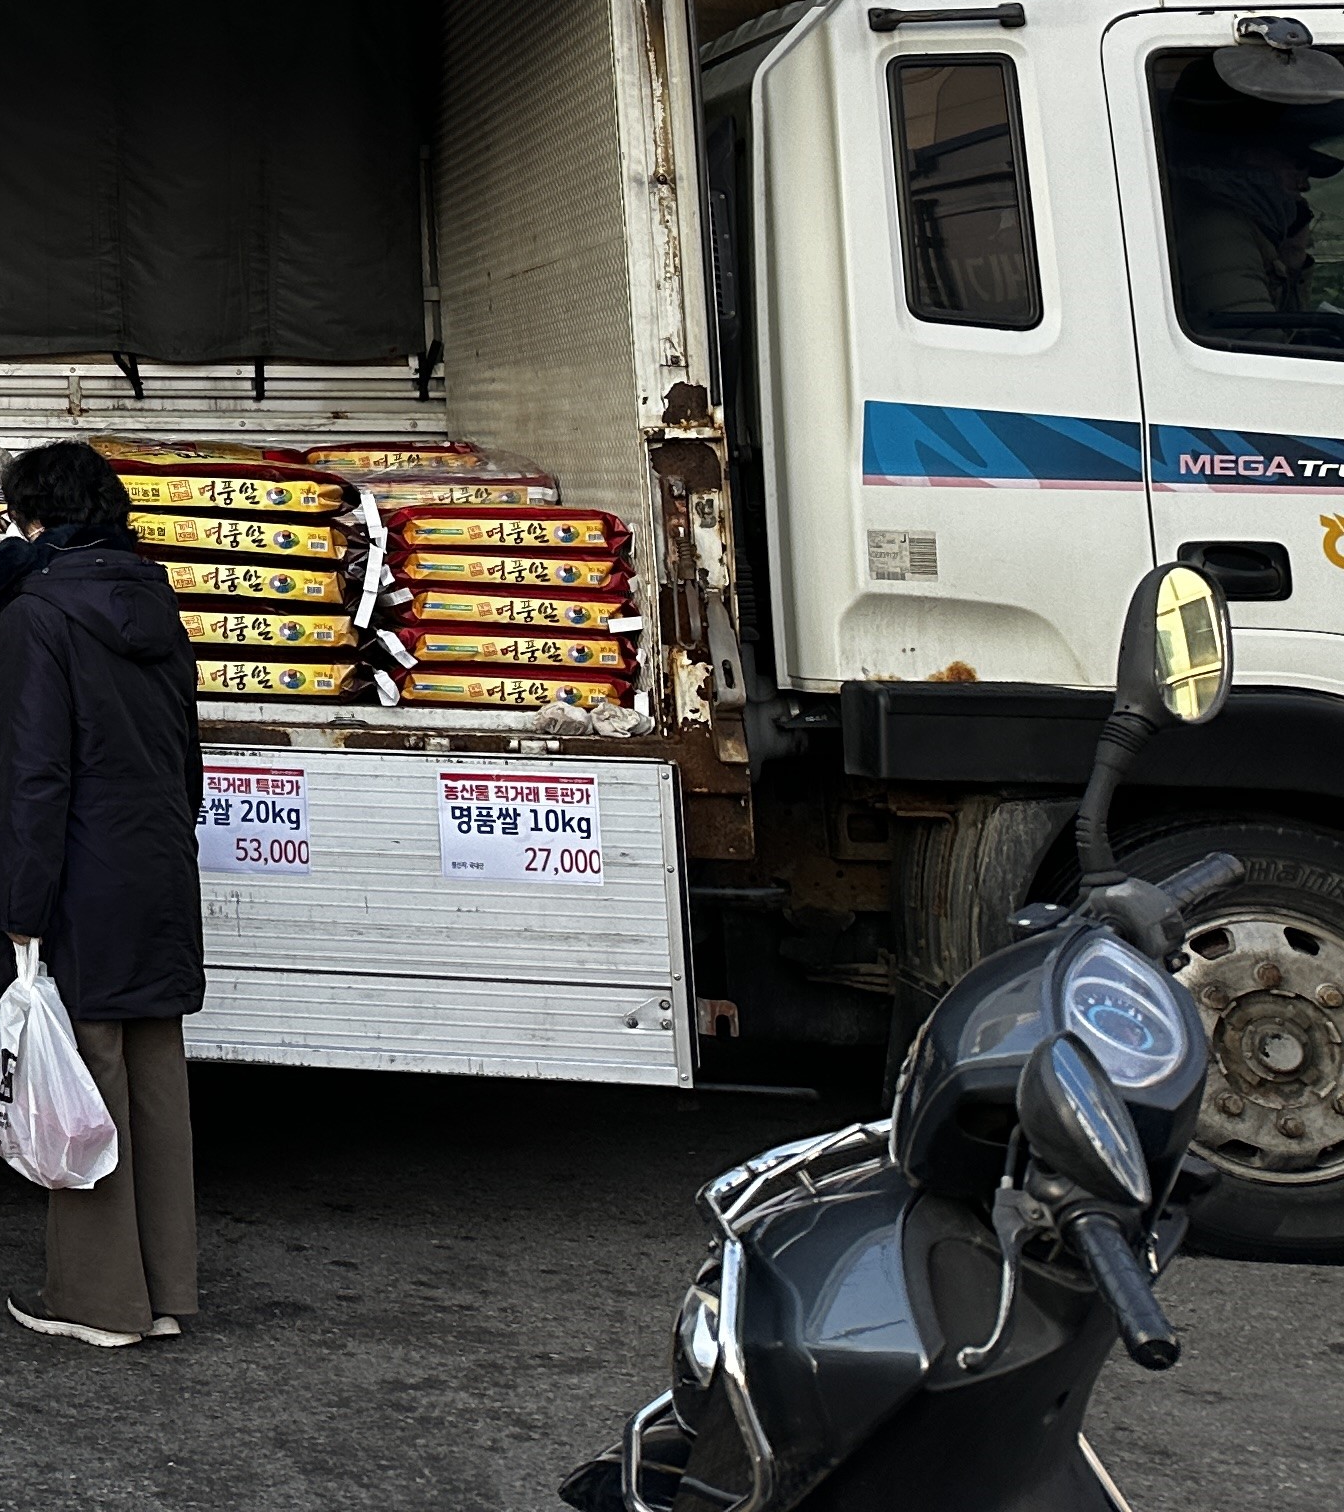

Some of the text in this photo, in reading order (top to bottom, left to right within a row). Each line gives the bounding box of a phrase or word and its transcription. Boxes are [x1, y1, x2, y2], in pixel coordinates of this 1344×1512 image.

[1179, 454, 1344, 477] MEGA Tr
[125, 487, 160, 498] 마농협
[199, 480, 260, 506] 명품쌀
[204, 521, 267, 549] 명품쌀
[486, 521, 550, 544] 명품쌀
[202, 566, 264, 593] 명품쌀
[487, 560, 551, 584] 명품쌀
[495, 600, 560, 623] 명품쌀
[210, 616, 274, 642] 명품쌀
[500, 640, 563, 663] 명품쌀
[210, 664, 274, 690] 명품쌀
[487, 681, 551, 703] 명품쌀
[207, 777, 301, 796] 직거래 특판가
[444, 784, 591, 805] 농산물 직거래 특판가
[240, 799, 301, 830] 20kg
[450, 806, 592, 839] 명품쌀 10kg
[235, 838, 310, 865] 53,000
[524, 847, 601, 875] 27,000
